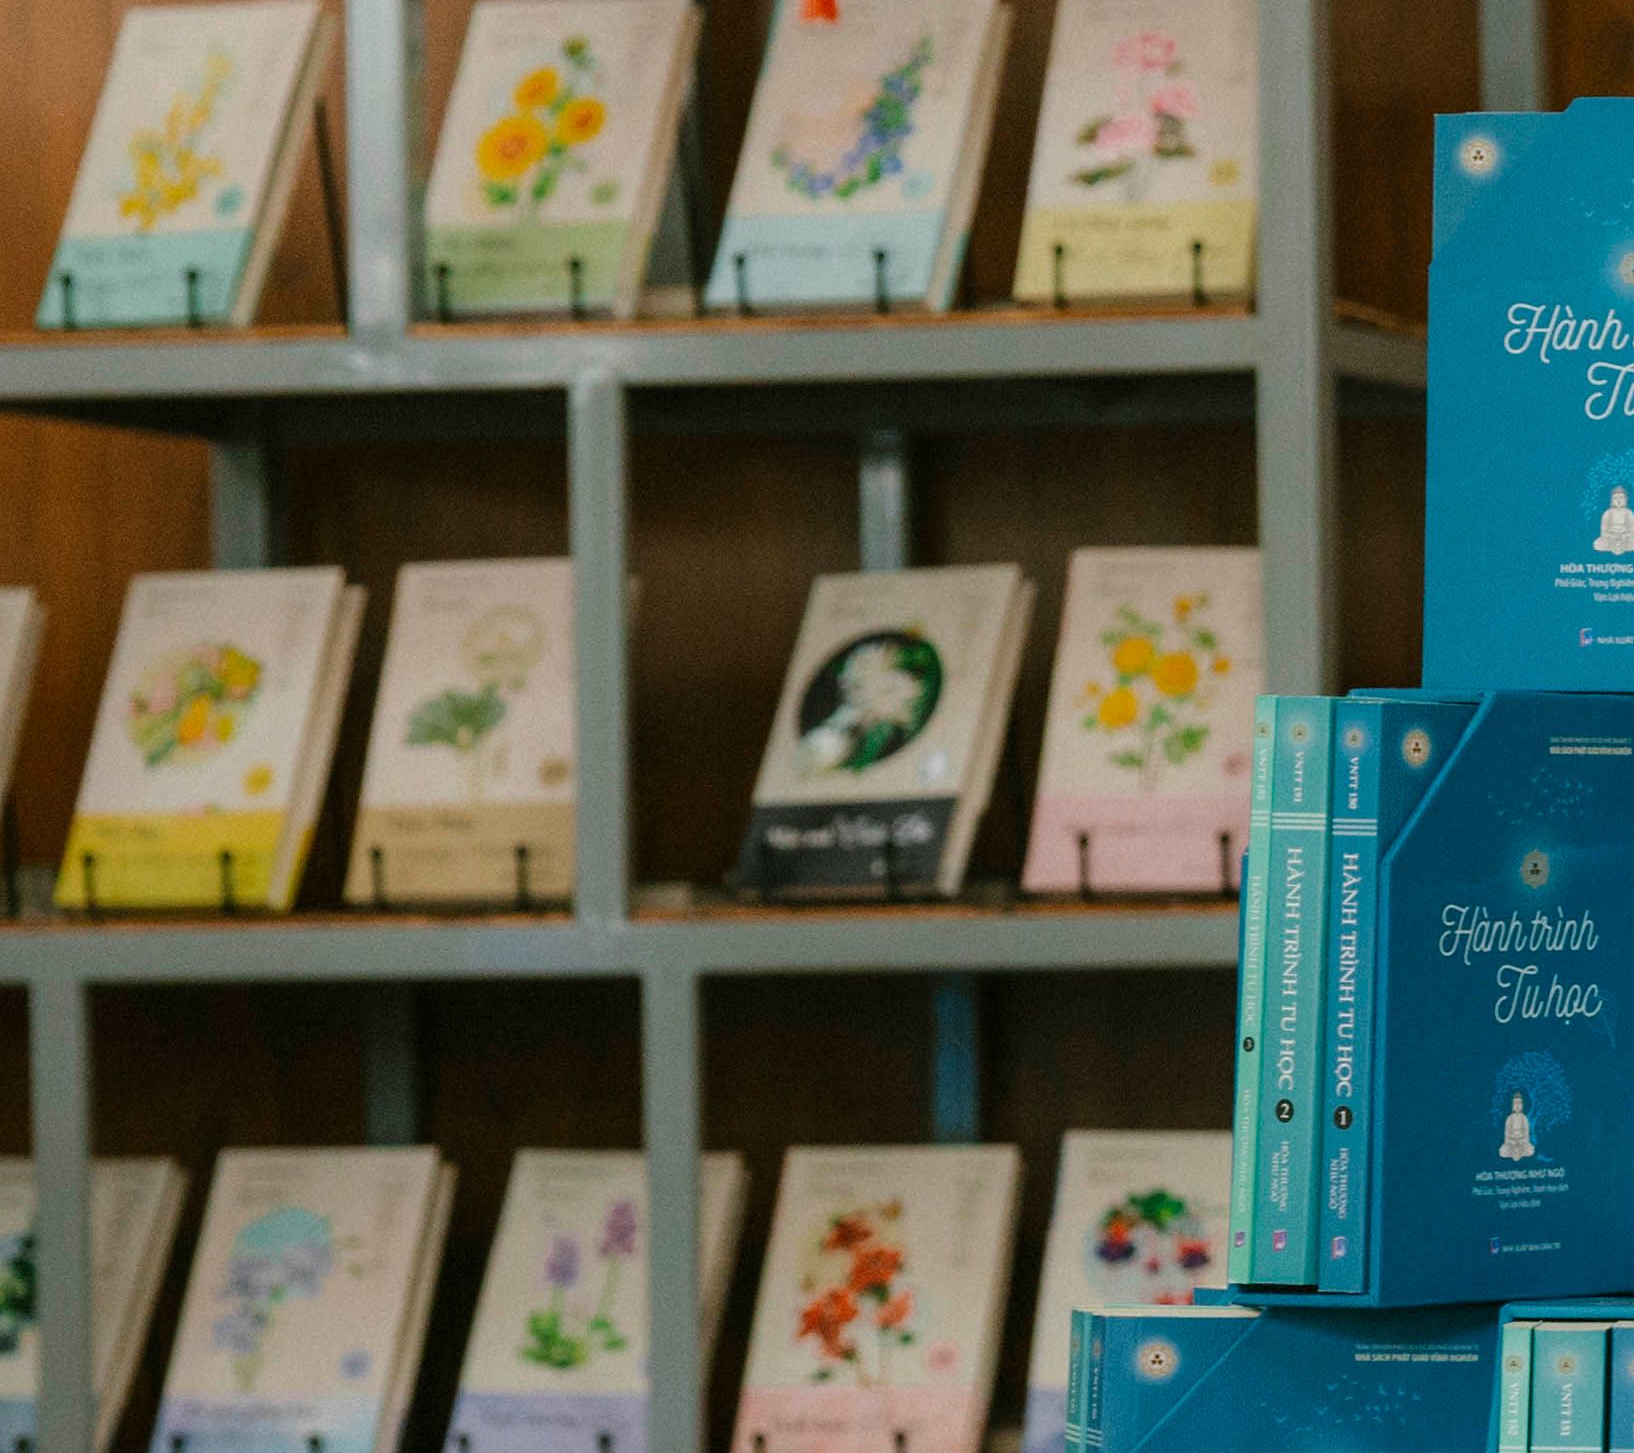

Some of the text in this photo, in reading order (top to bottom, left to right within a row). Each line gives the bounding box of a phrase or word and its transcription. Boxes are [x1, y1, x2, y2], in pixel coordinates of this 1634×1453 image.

[1503, 303, 1630, 364] Hành
[1293, 751, 1304, 782] VNTT
[1347, 756, 1359, 789] VNTT
[1438, 902, 1600, 966] Hành trình
[1275, 847, 1305, 1119] HÀNH TRÌNH TU HỌC 2
[1334, 853, 1361, 1126] HÀNH TRÌNH TU HỌC 1
[1494, 963, 1603, 1026] Tu học
[1560, 1381, 1572, 1417] VNTT
